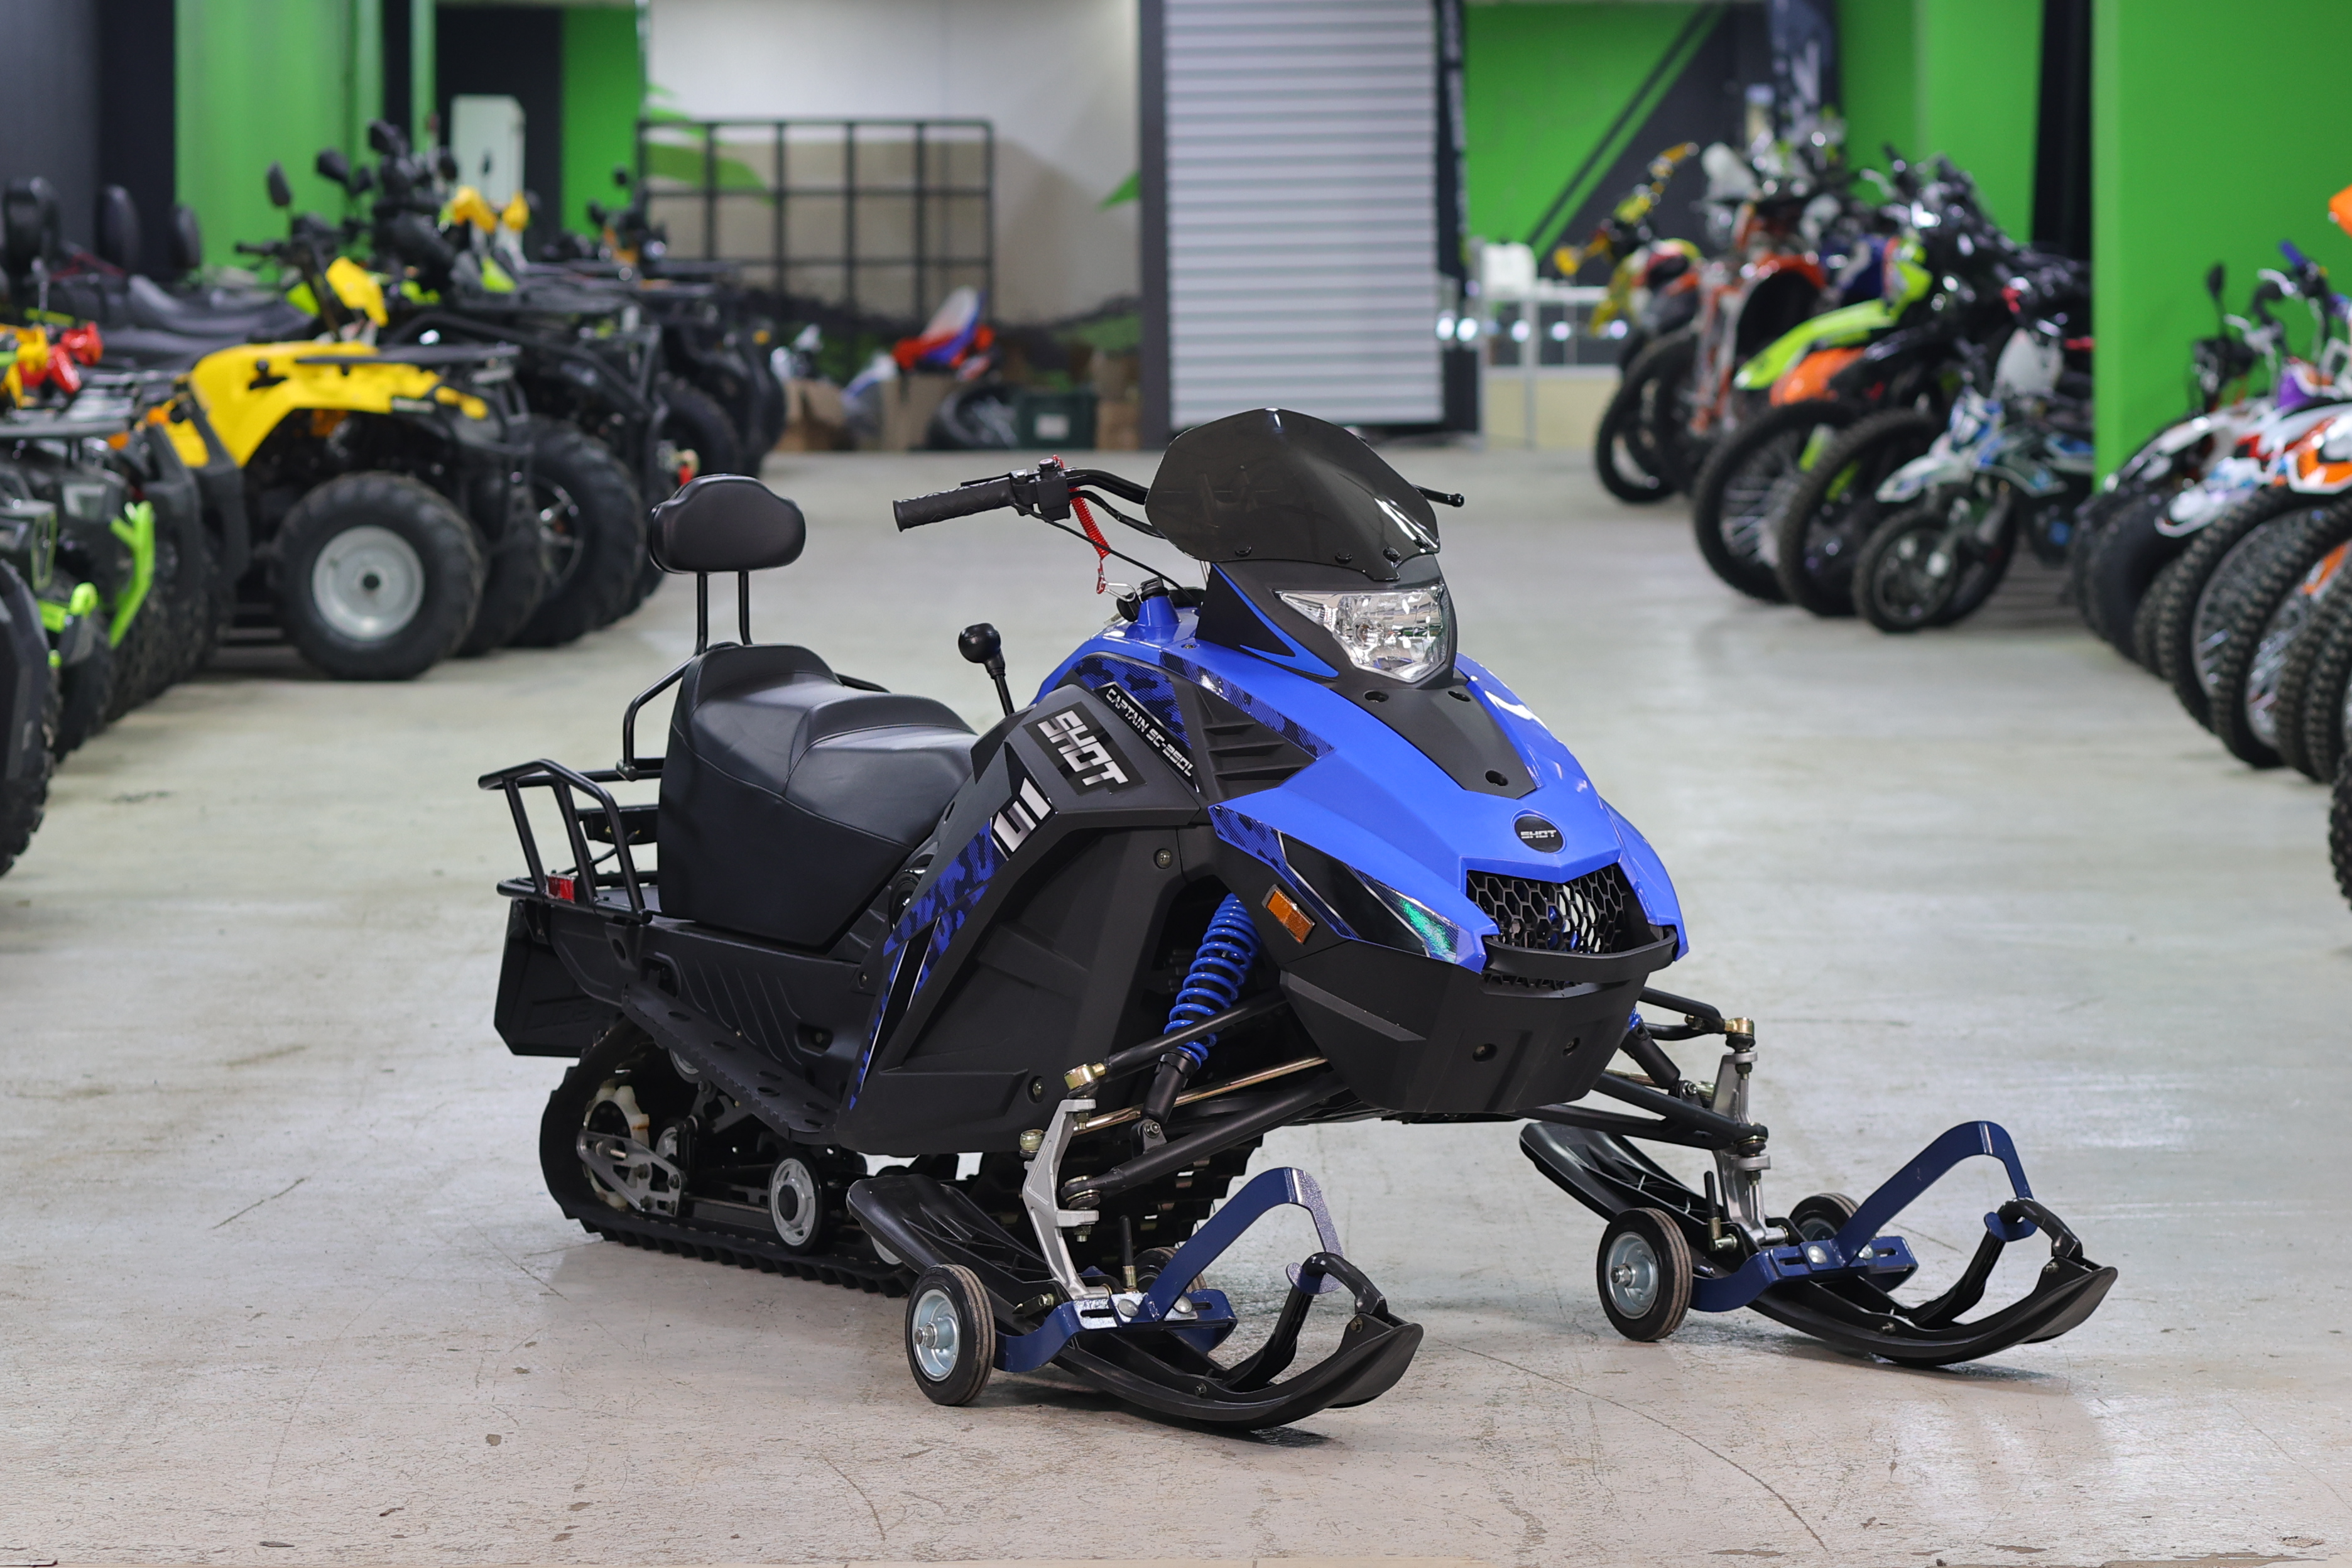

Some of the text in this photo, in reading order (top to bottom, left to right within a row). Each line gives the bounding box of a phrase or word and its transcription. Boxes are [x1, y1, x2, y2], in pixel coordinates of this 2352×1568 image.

[1037, 710, 1129, 786] SHOT
[1106, 688, 1194, 777] CAPTAIN SC-250L
[1520, 830, 1557, 839] SHOT
